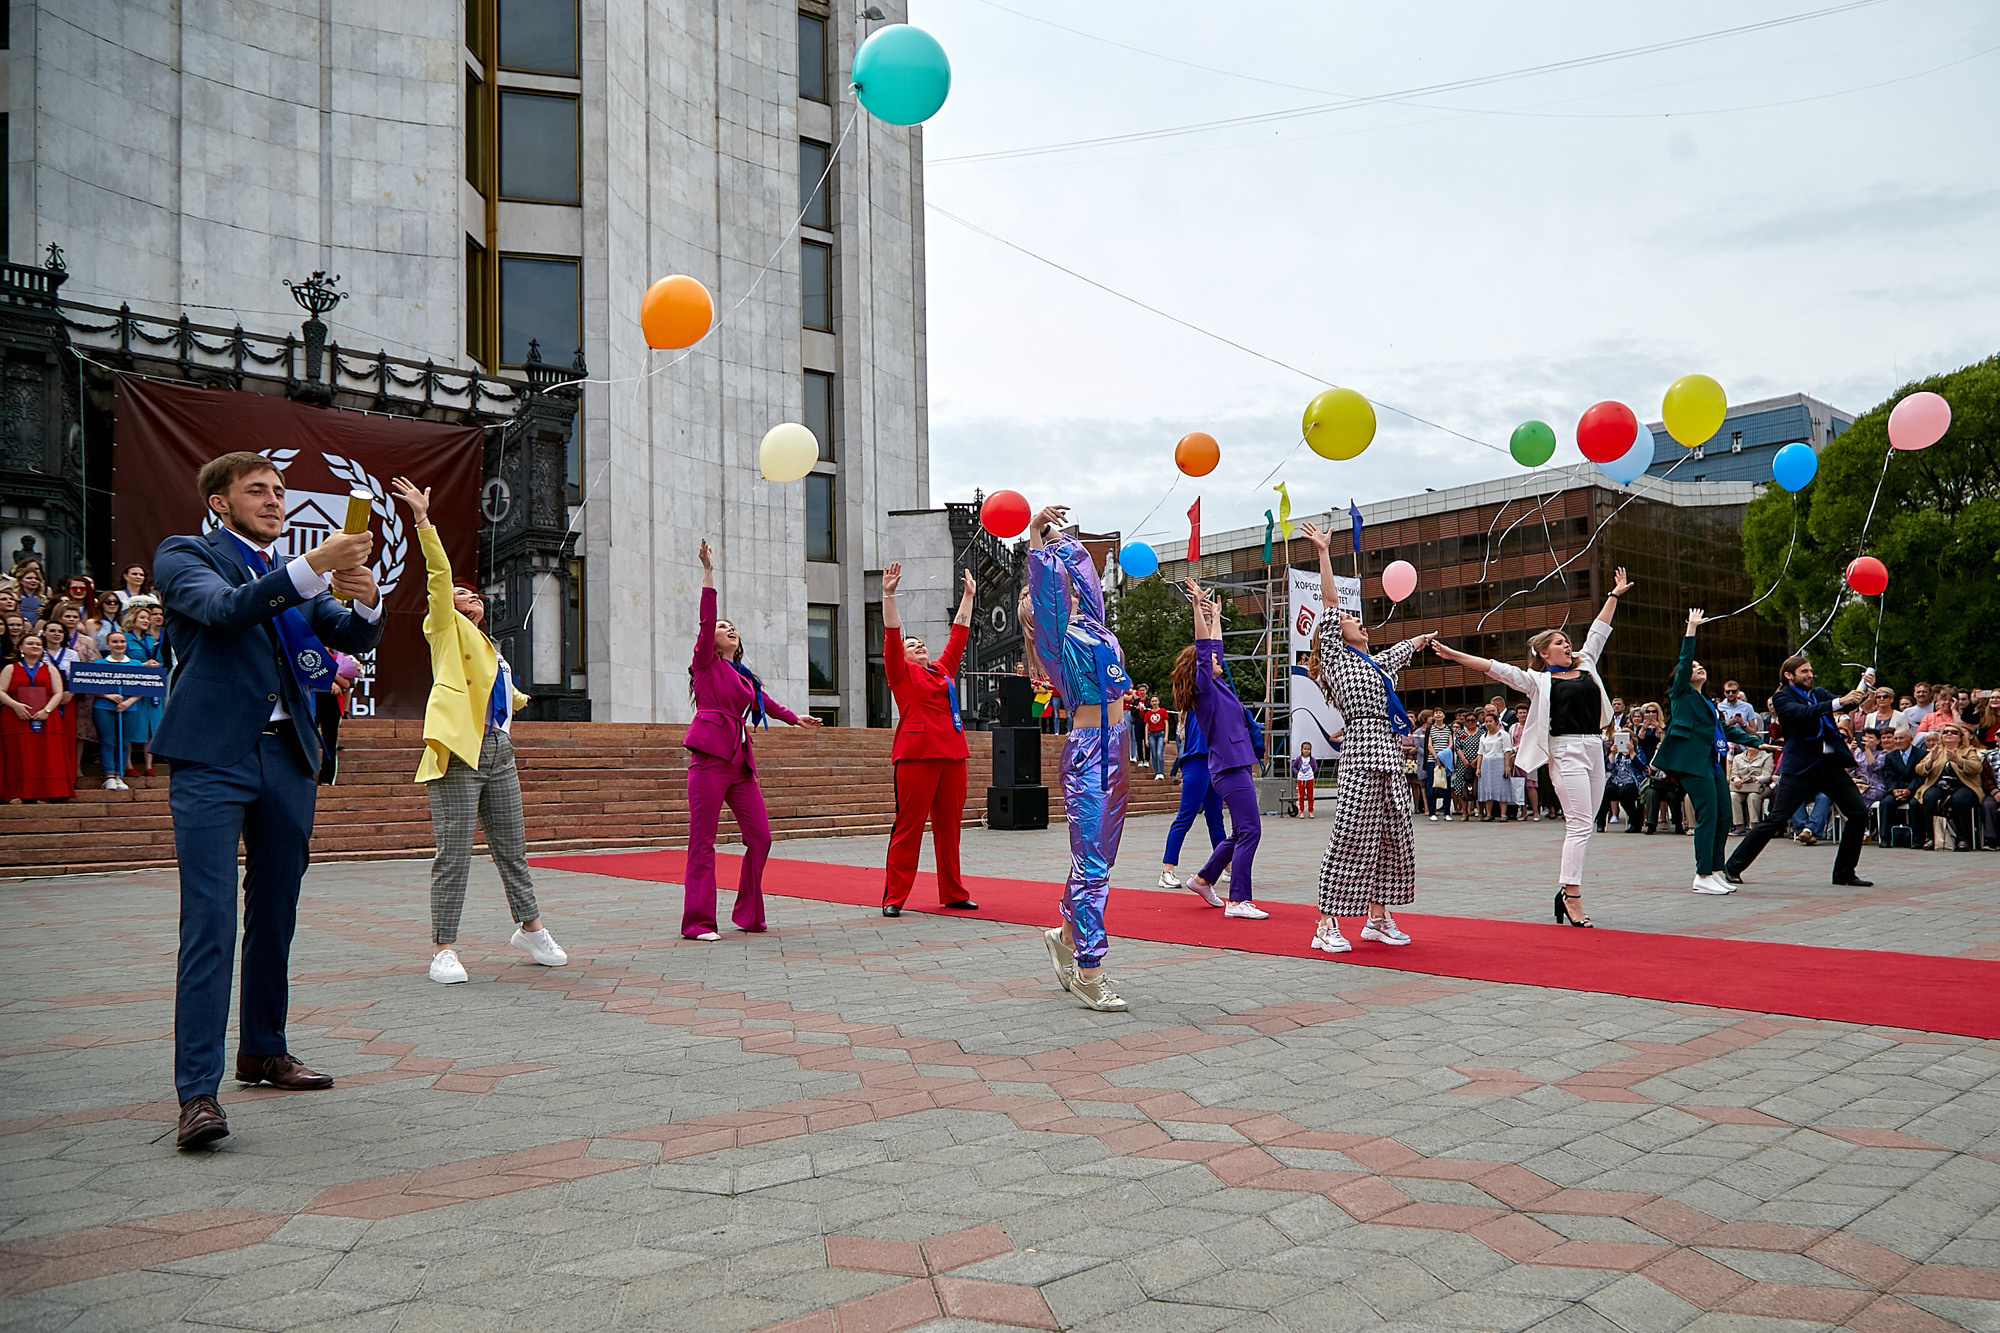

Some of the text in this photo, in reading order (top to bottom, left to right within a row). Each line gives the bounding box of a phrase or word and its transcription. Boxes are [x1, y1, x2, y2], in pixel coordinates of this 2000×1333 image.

[1295, 581, 1359, 596] ХОРЕОГЧЕСКИЙ
[1313, 593, 1348, 605] ФАТЕТ
[113, 672, 162, 680] ДЕКОРАТИВНО-
[309, 667, 328, 679] ЧГИК
